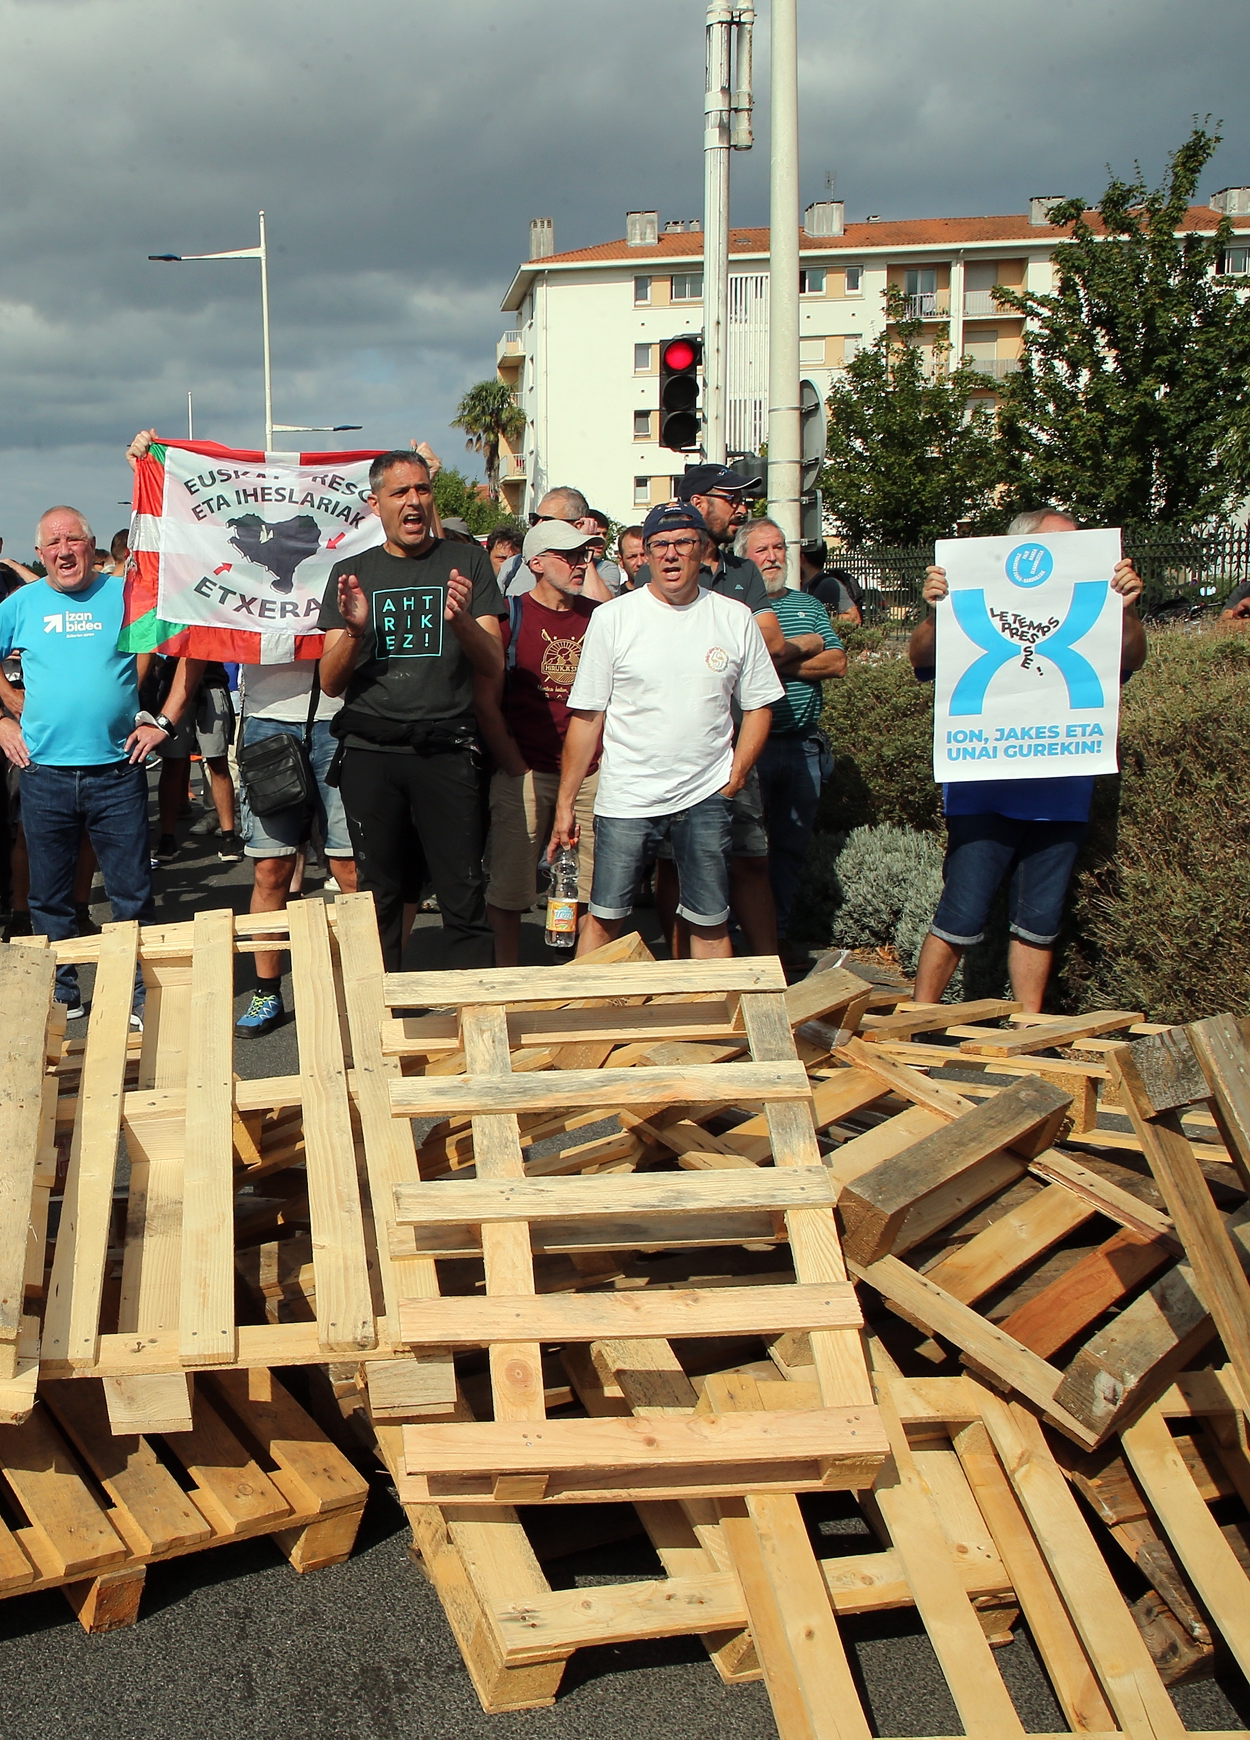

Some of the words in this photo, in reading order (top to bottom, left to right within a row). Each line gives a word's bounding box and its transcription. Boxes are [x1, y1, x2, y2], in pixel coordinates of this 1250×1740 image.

[191, 494, 232, 521] ETA
[234, 486, 366, 530] IHESLARIAK
[65, 610, 93, 622] izan
[65, 620, 103, 633] bidea
[989, 607, 1009, 622] LE
[1011, 616, 1060, 637] TEMPS
[946, 729, 989, 745] ION,
[994, 725, 1060, 742] JAKES
[1065, 722, 1104, 738] ETA
[946, 745, 998, 761] UNAI
[1003, 740, 1103, 759] GUREKIN!
